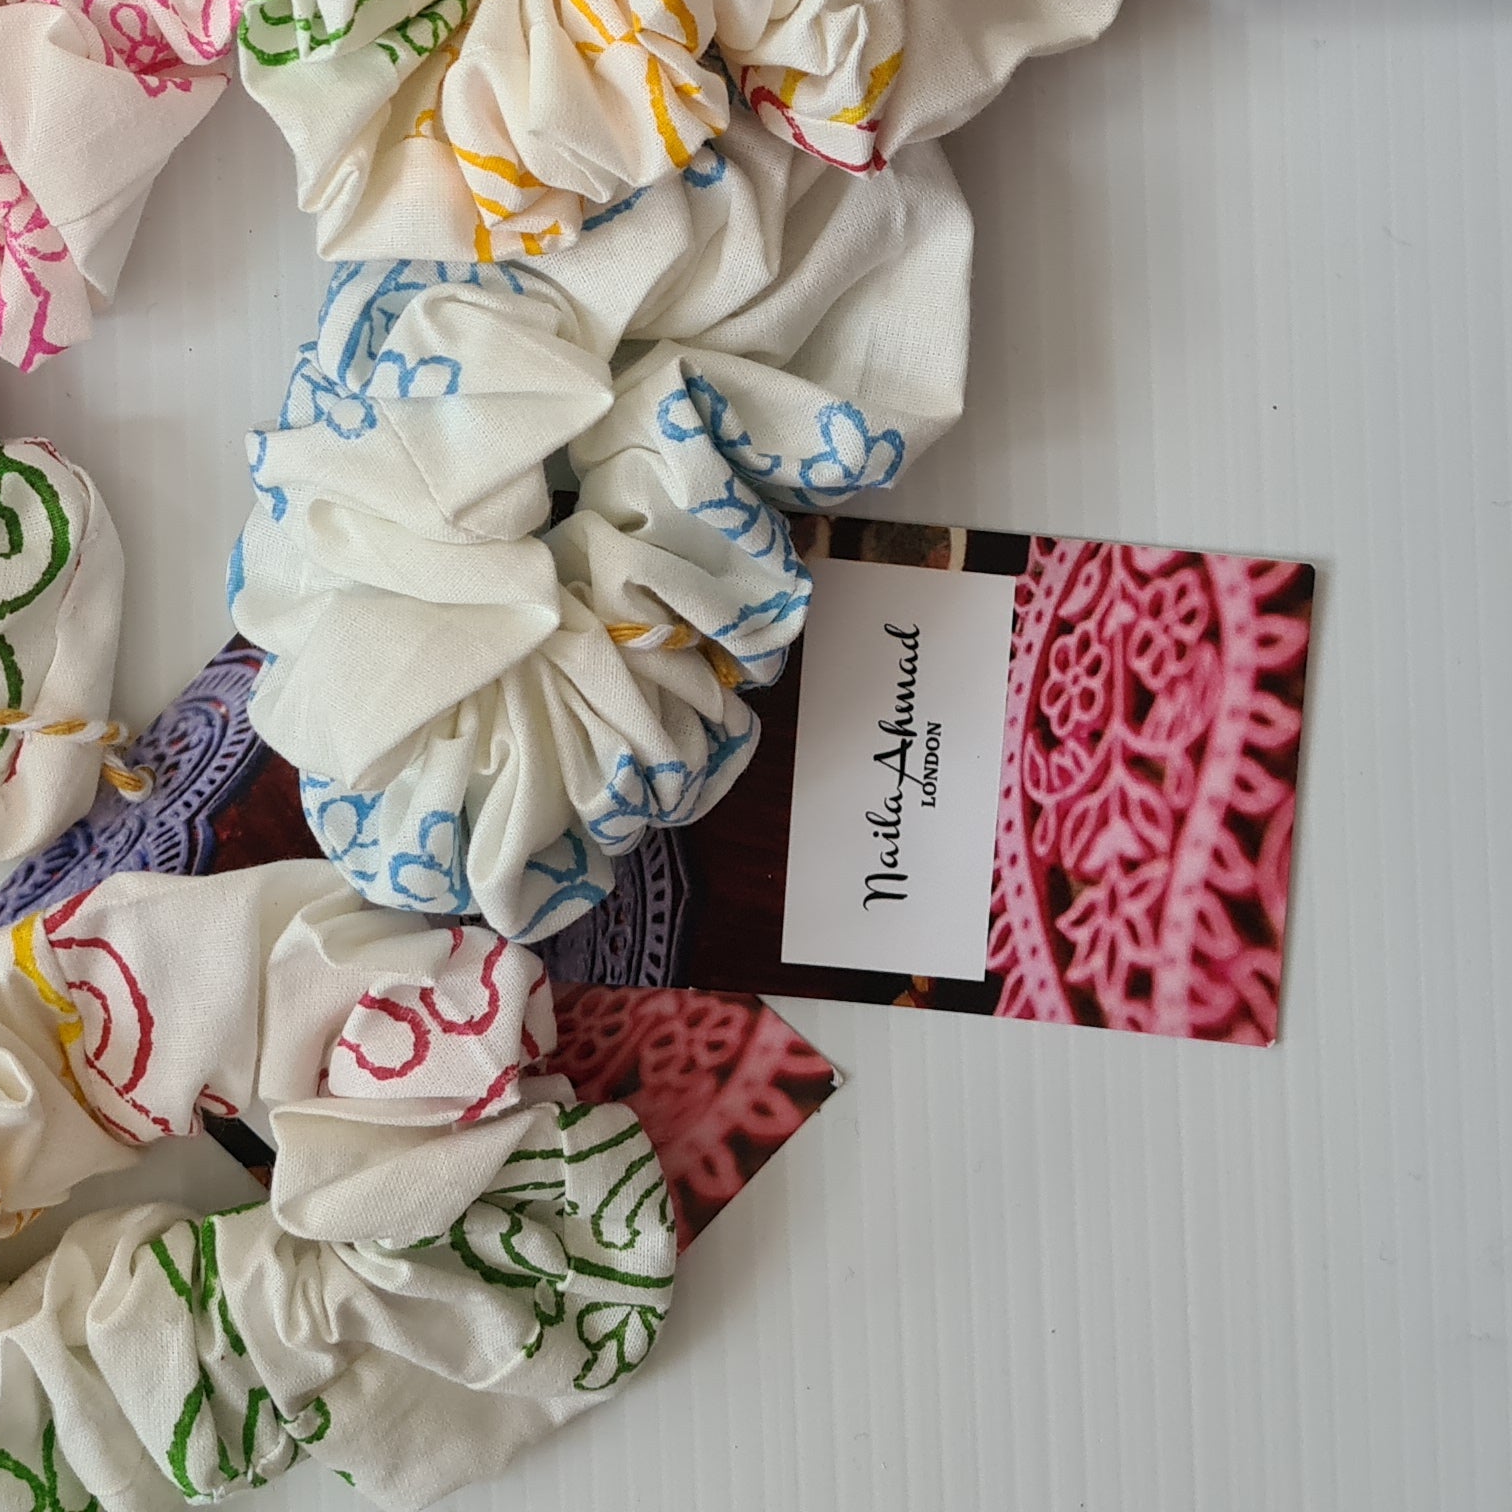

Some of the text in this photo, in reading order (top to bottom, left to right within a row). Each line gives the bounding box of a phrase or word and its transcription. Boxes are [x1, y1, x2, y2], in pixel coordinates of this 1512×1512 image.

[862, 622, 926, 911] Naila Ahmad
[921, 721, 942, 808] LONDON
